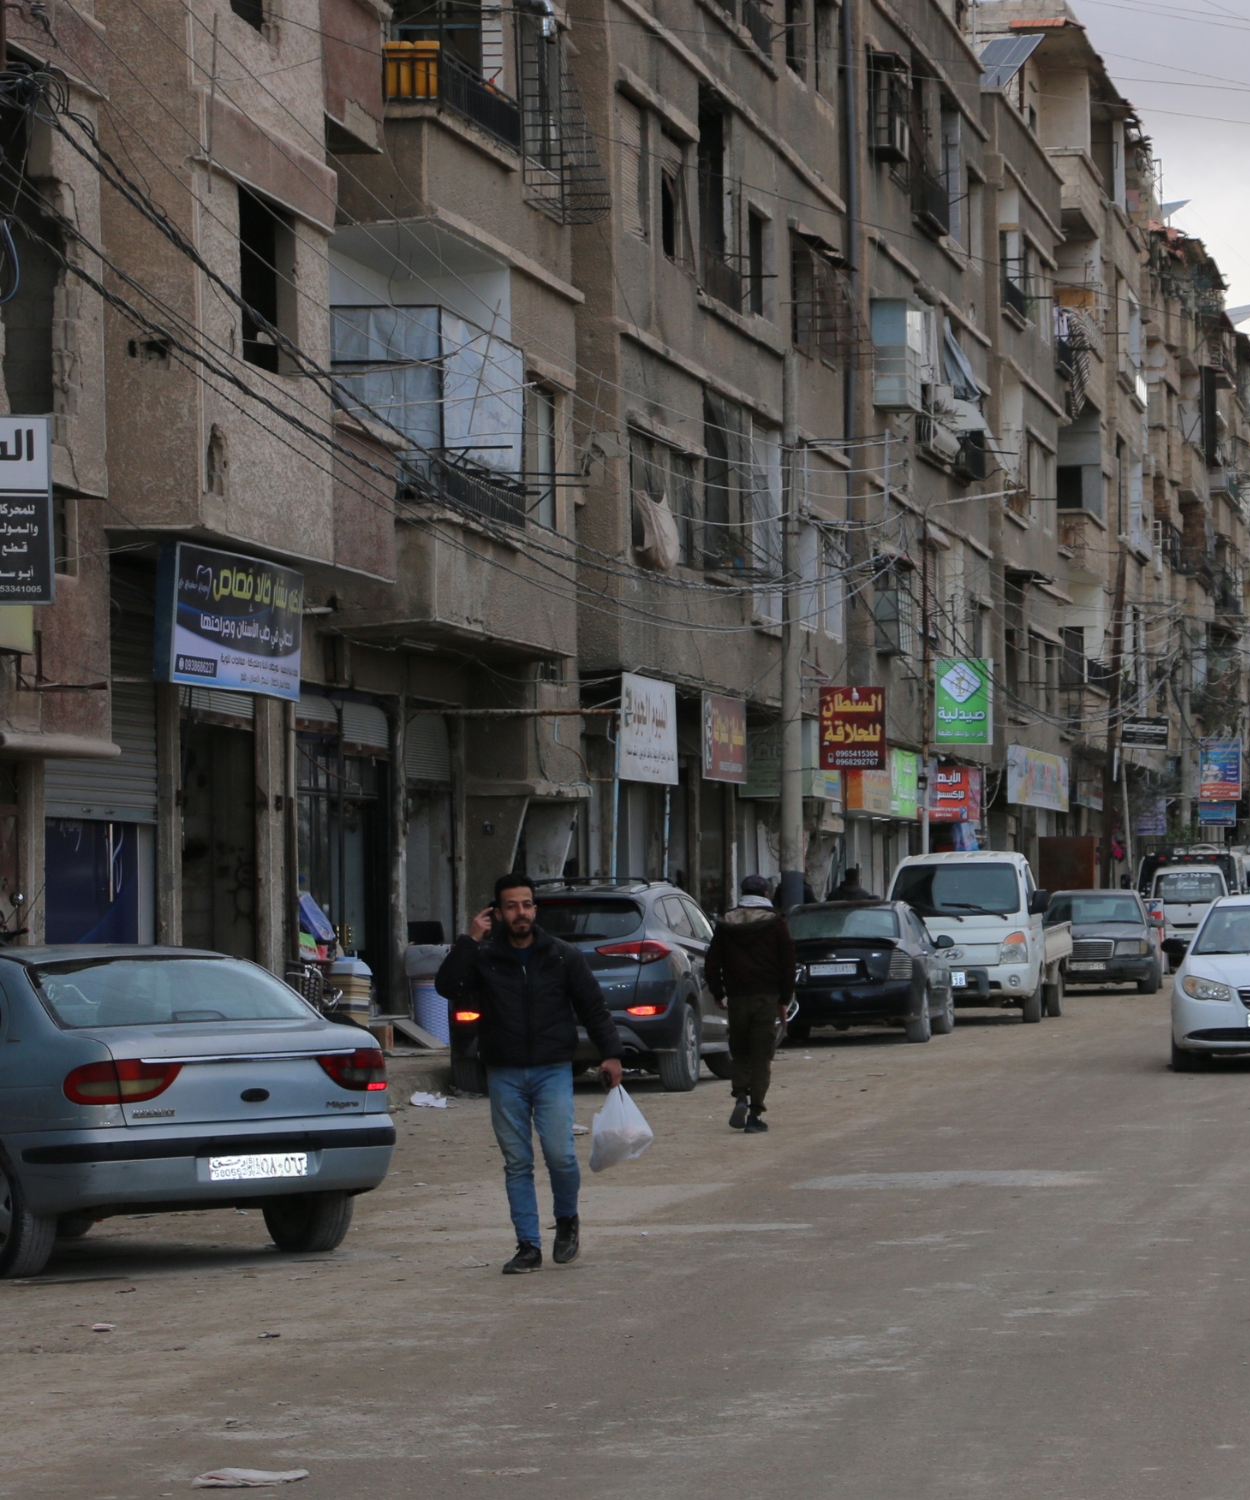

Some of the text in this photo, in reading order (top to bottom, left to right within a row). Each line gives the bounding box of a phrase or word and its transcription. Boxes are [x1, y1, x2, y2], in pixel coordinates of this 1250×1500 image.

[0, 585, 42, 593] 53341005
[213, 566, 254, 601] قصاص
[254, 572, 272, 604] خالد
[200, 613, 235, 638] وجراحتها
[236, 618, 260, 639] الأسنان
[259, 624, 270, 643] طب
[270, 627, 279, 649] في
[938, 706, 986, 723] صيدلية
[823, 720, 882, 744] للحلاقة
[937, 769, 961, 785] الأيه
[211, 1158, 246, 1169] دمشق
